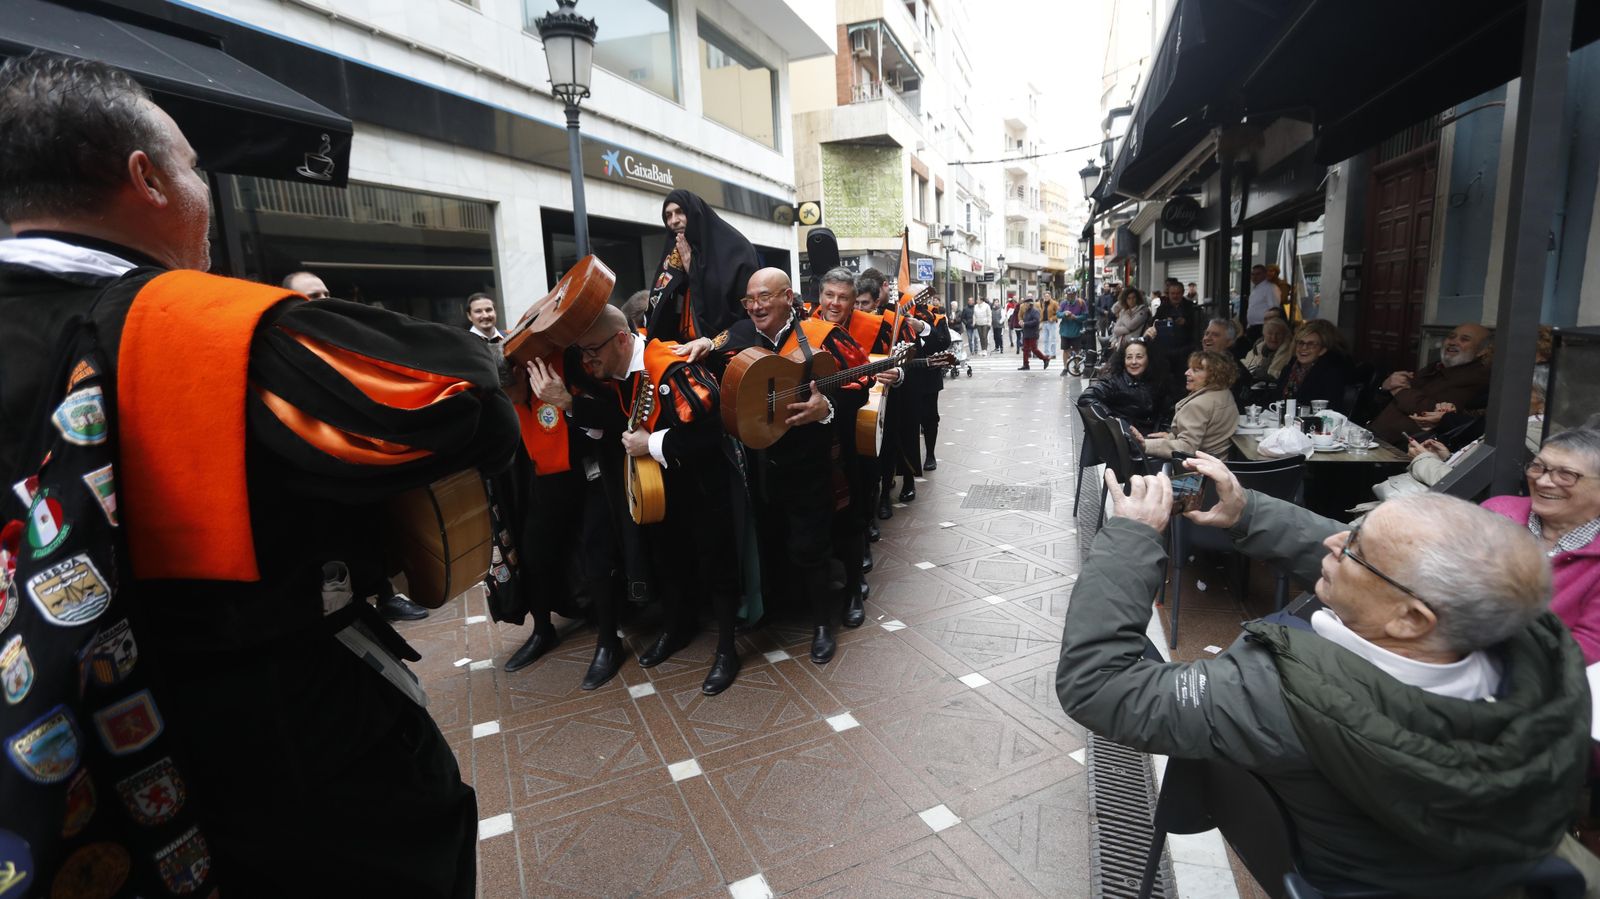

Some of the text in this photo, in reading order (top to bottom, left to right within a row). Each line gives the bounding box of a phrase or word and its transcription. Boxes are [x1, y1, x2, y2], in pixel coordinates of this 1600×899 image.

[624, 155, 674, 187] CaixaBank
[33, 558, 81, 584] LISBOA
[155, 827, 199, 860] GRANADA
